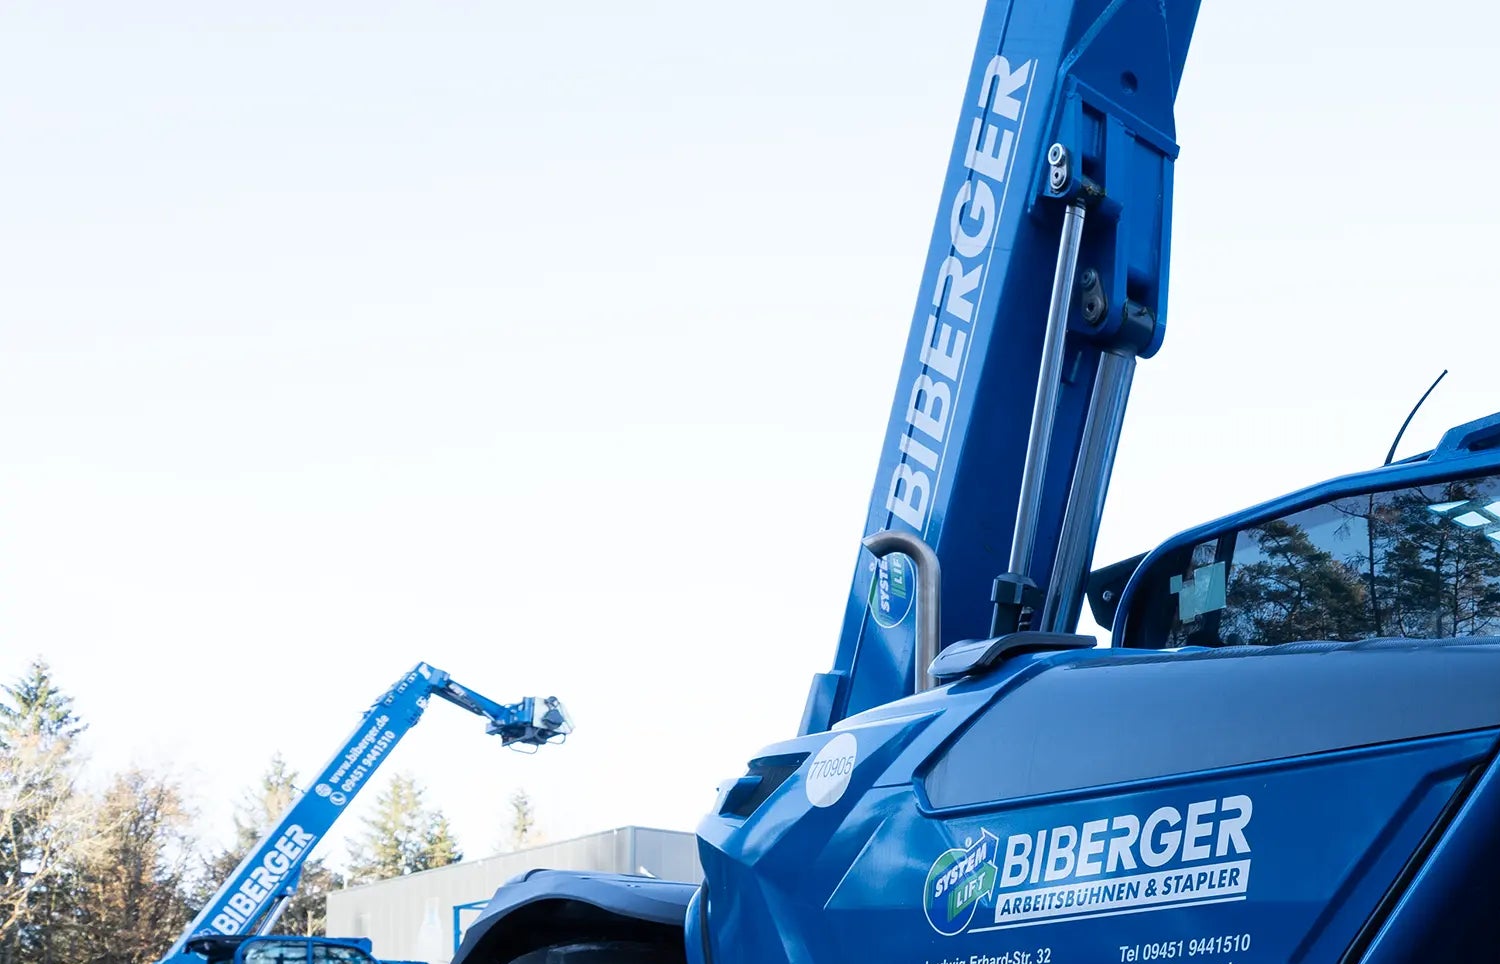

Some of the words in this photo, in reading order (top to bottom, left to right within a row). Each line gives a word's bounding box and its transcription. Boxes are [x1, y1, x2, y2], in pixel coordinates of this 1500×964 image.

[886, 55, 1031, 532] BIBERGER
[329, 714, 390, 784] www.biberger.de
[341, 765, 368, 792] 09451
[362, 730, 396, 767] 9441510
[809, 756, 854, 780] 770905
[1000, 794, 1253, 888] BIBERGER
[211, 824, 314, 936] BIBERGER
[934, 842, 987, 898] SYSTEM
[956, 871, 986, 908] LIFT
[1000, 879, 1138, 917] ARBEITSBÜHNEN
[1145, 880, 1158, 898] &
[1161, 867, 1241, 895] STAPLER
[1036, 947, 1051, 964] 32
[1119, 944, 1140, 963] Tel
[1142, 940, 1184, 960] 09451
[1188, 933, 1251, 956] 9441510
